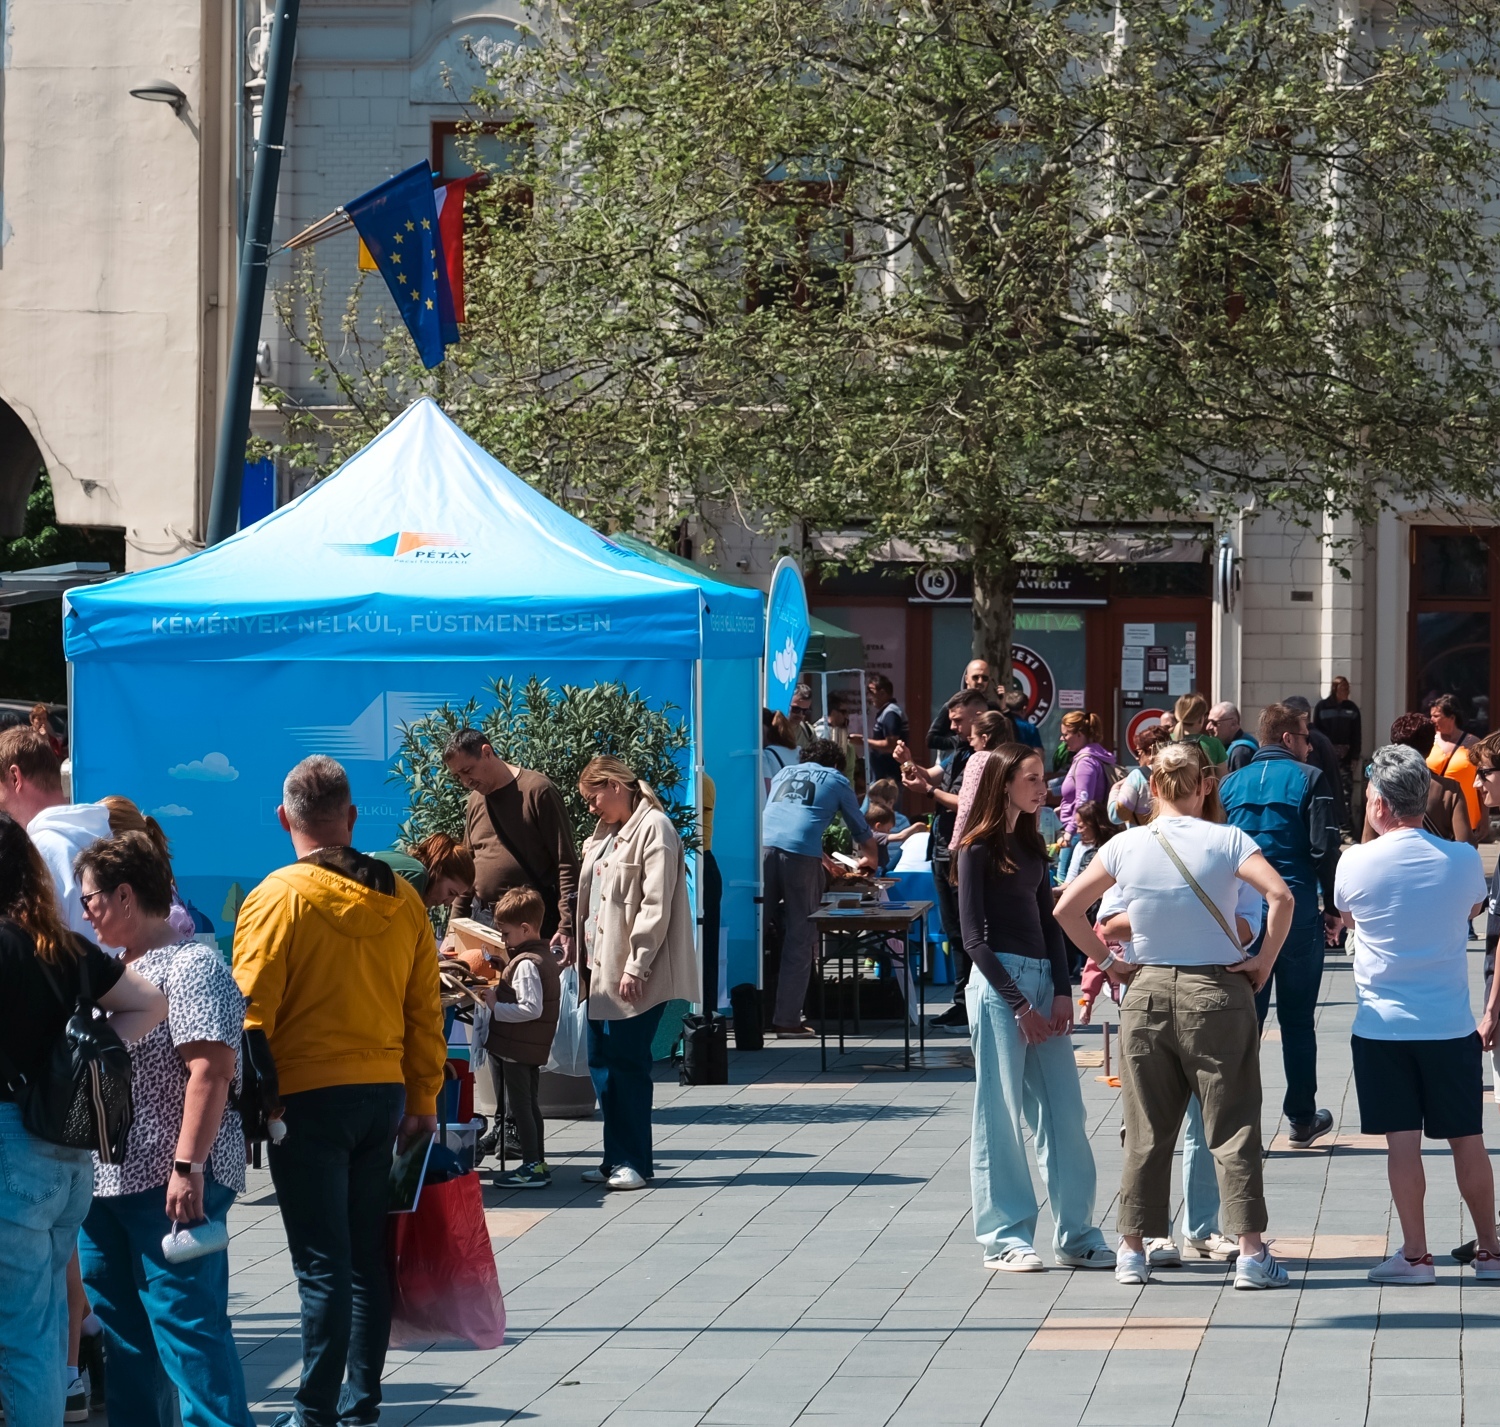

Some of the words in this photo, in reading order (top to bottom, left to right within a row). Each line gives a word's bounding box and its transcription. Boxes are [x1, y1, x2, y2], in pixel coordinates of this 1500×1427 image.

[415, 549, 471, 559] PÉTÁV
[927, 575, 945, 588] 18
[152, 612, 287, 634] KÉMÉNYEK
[299, 610, 402, 635] NÉLKÜL,
[411, 610, 610, 632] FÜSTMENTESEN
[1015, 613, 1081, 631] NYITVA
[357, 804, 398, 817] ÉLKÜL,
